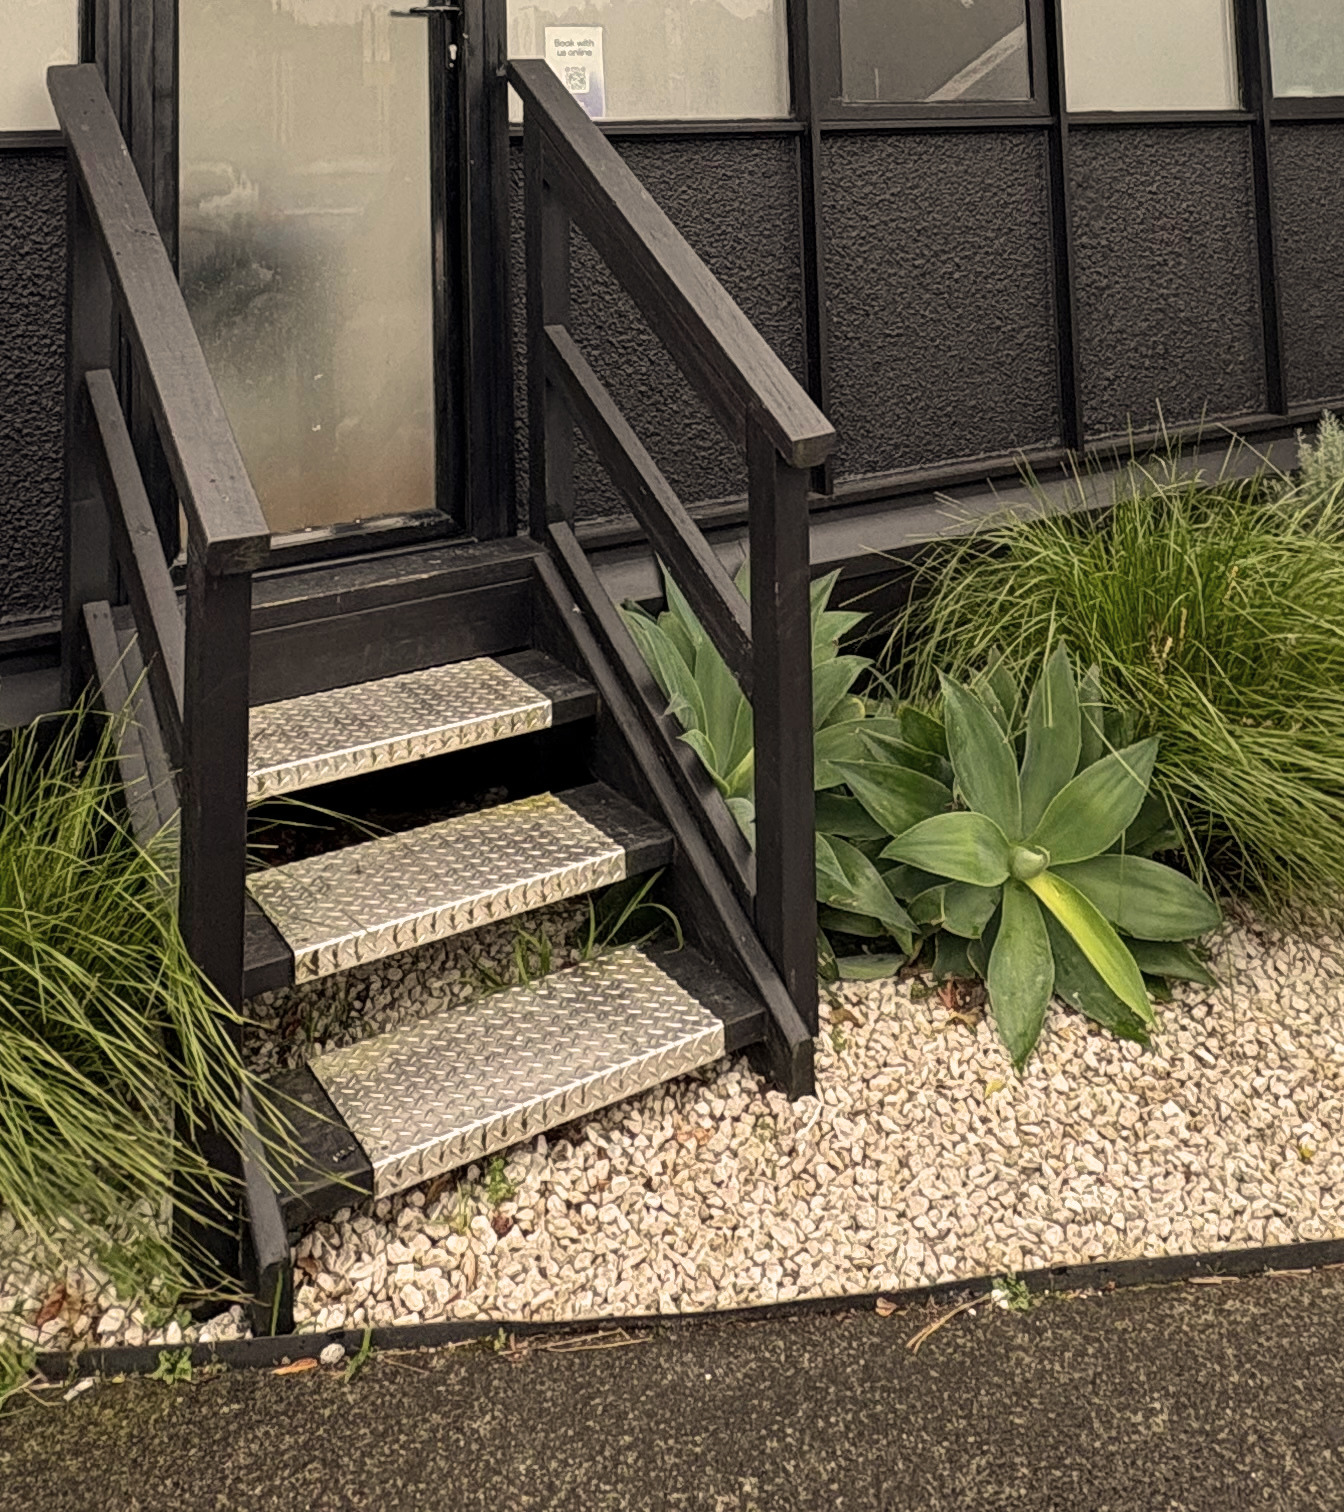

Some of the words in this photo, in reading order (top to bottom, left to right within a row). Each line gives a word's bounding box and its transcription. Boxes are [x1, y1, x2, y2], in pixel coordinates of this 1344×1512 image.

[554, 38, 574, 47] Book
[577, 39, 595, 47] with
[568, 48, 593, 56] online
